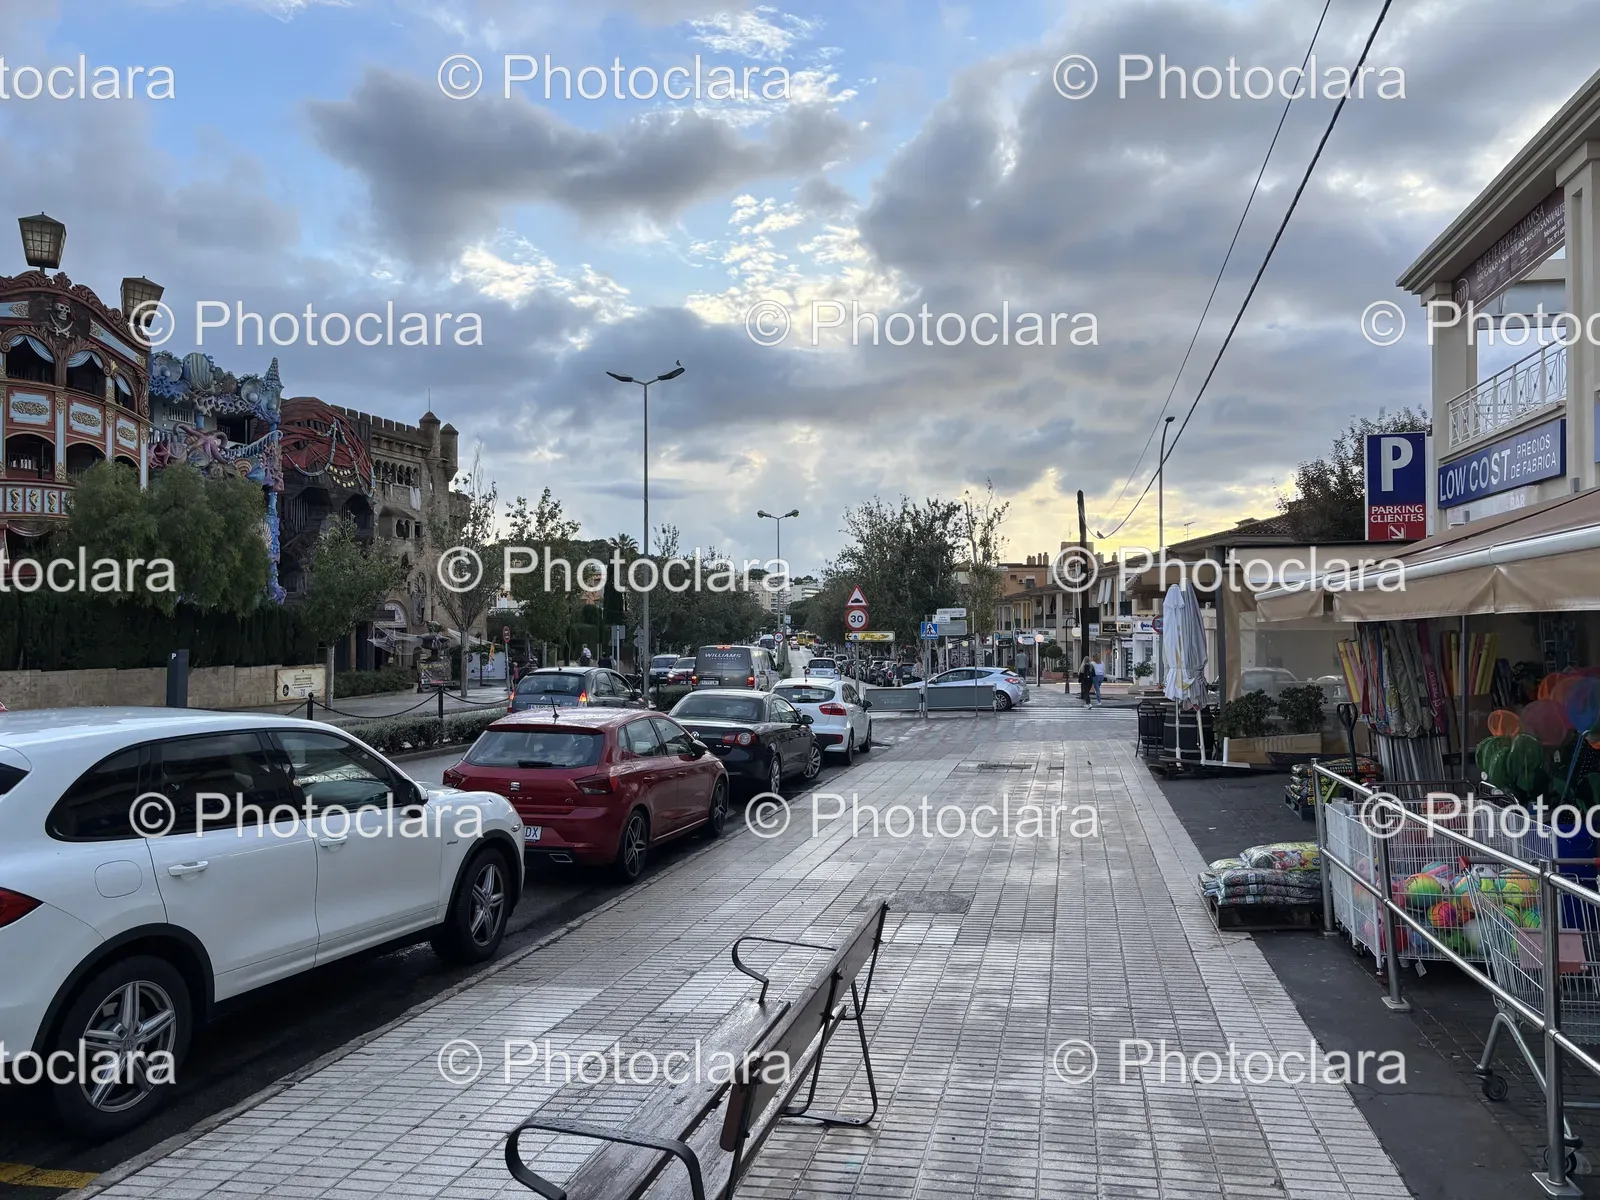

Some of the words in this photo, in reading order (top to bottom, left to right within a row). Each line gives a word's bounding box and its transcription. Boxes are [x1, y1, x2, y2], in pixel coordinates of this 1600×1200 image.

[1516, 434, 1551, 459] PRECIOS
[1380, 437, 1413, 492] P
[1511, 463, 1521, 479] DE
[1522, 452, 1557, 476] FABRICA
[1440, 465, 1467, 502] LOW
[1469, 449, 1511, 492] COST
[1371, 505, 1423, 514] PARKING
[1370, 513, 1424, 523] CLIENTES
[850, 615, 864, 623] 30
[171, 652, 177, 660] P
[525, 827, 539, 838] DX
